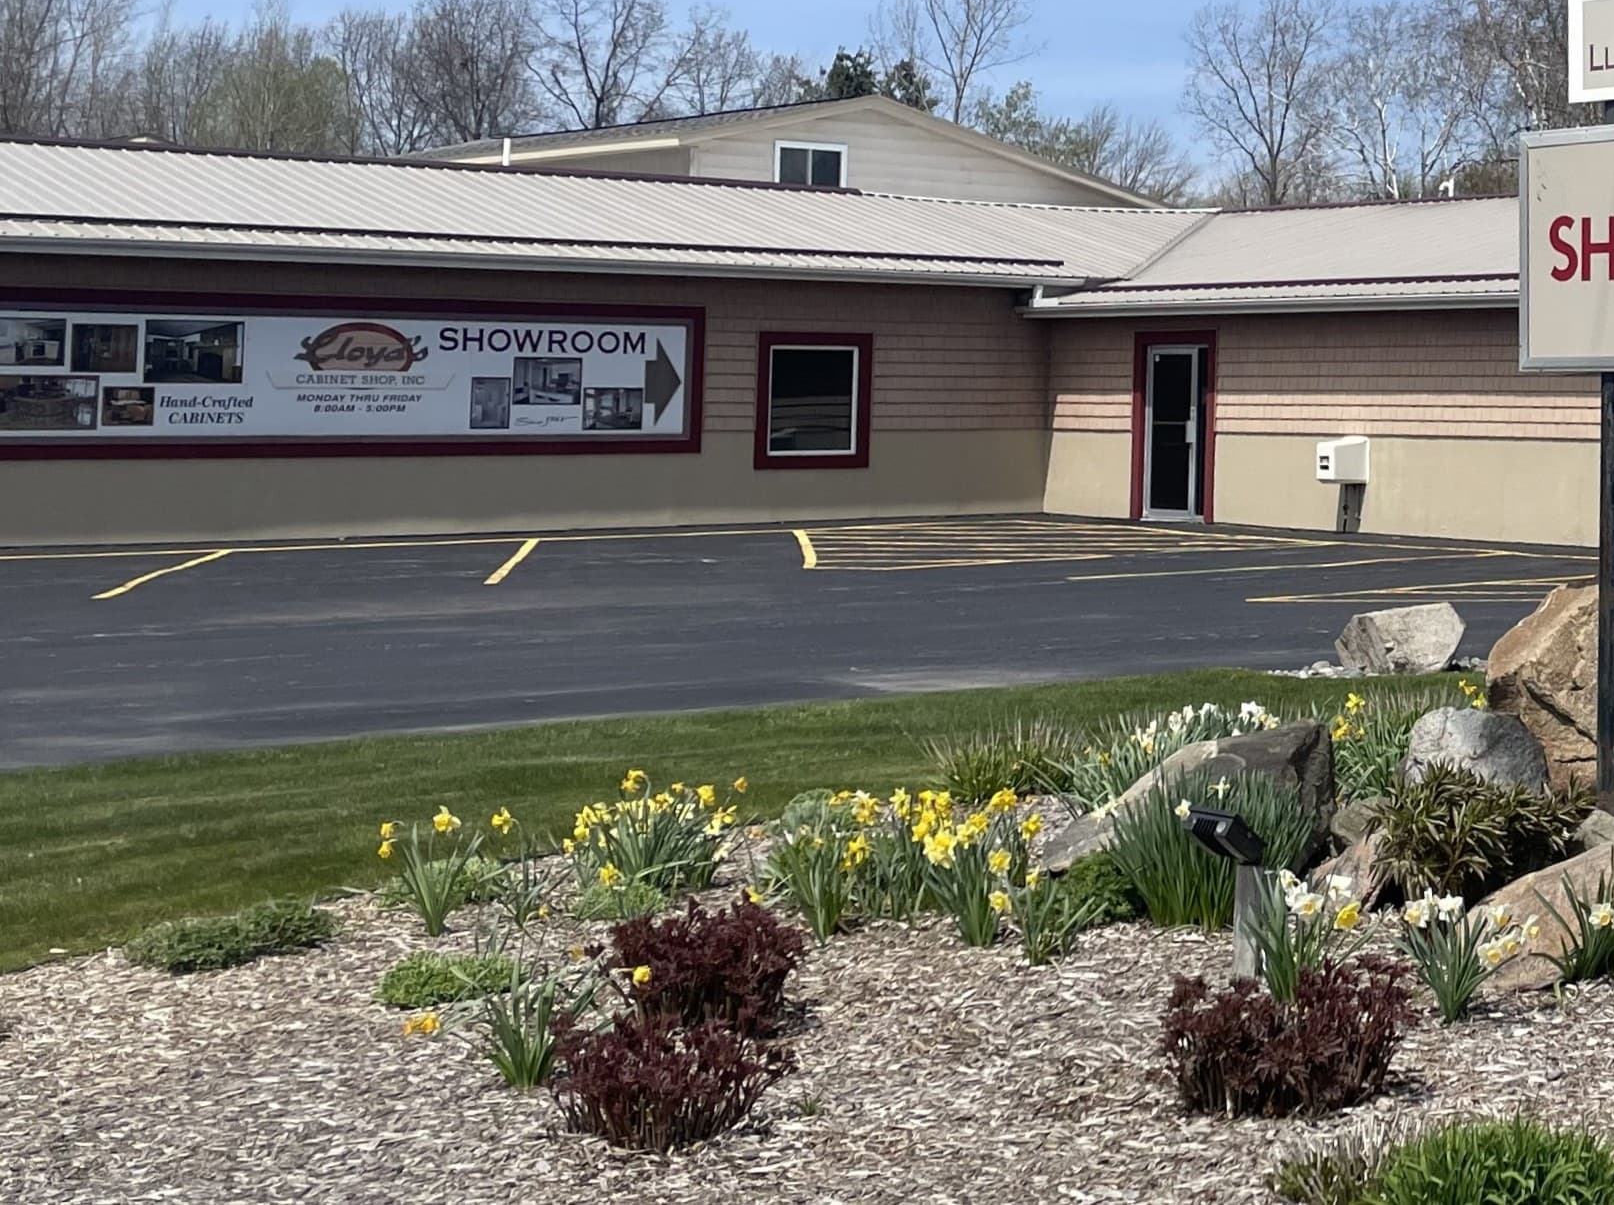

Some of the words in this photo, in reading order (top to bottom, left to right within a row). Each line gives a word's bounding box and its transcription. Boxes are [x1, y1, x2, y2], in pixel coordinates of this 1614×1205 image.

[439, 327, 646, 354] SHOWROOM
[293, 330, 429, 367] Lloyd's
[295, 374, 357, 385] CABINET
[361, 375, 398, 386] SHOP,
[401, 375, 425, 385] INC
[160, 395, 254, 410] Hand-Crafted
[296, 394, 345, 402] MONDAY
[350, 394, 379, 402] THRU
[382, 394, 422, 402] FRIDAY
[168, 412, 245, 424] CABINETS
